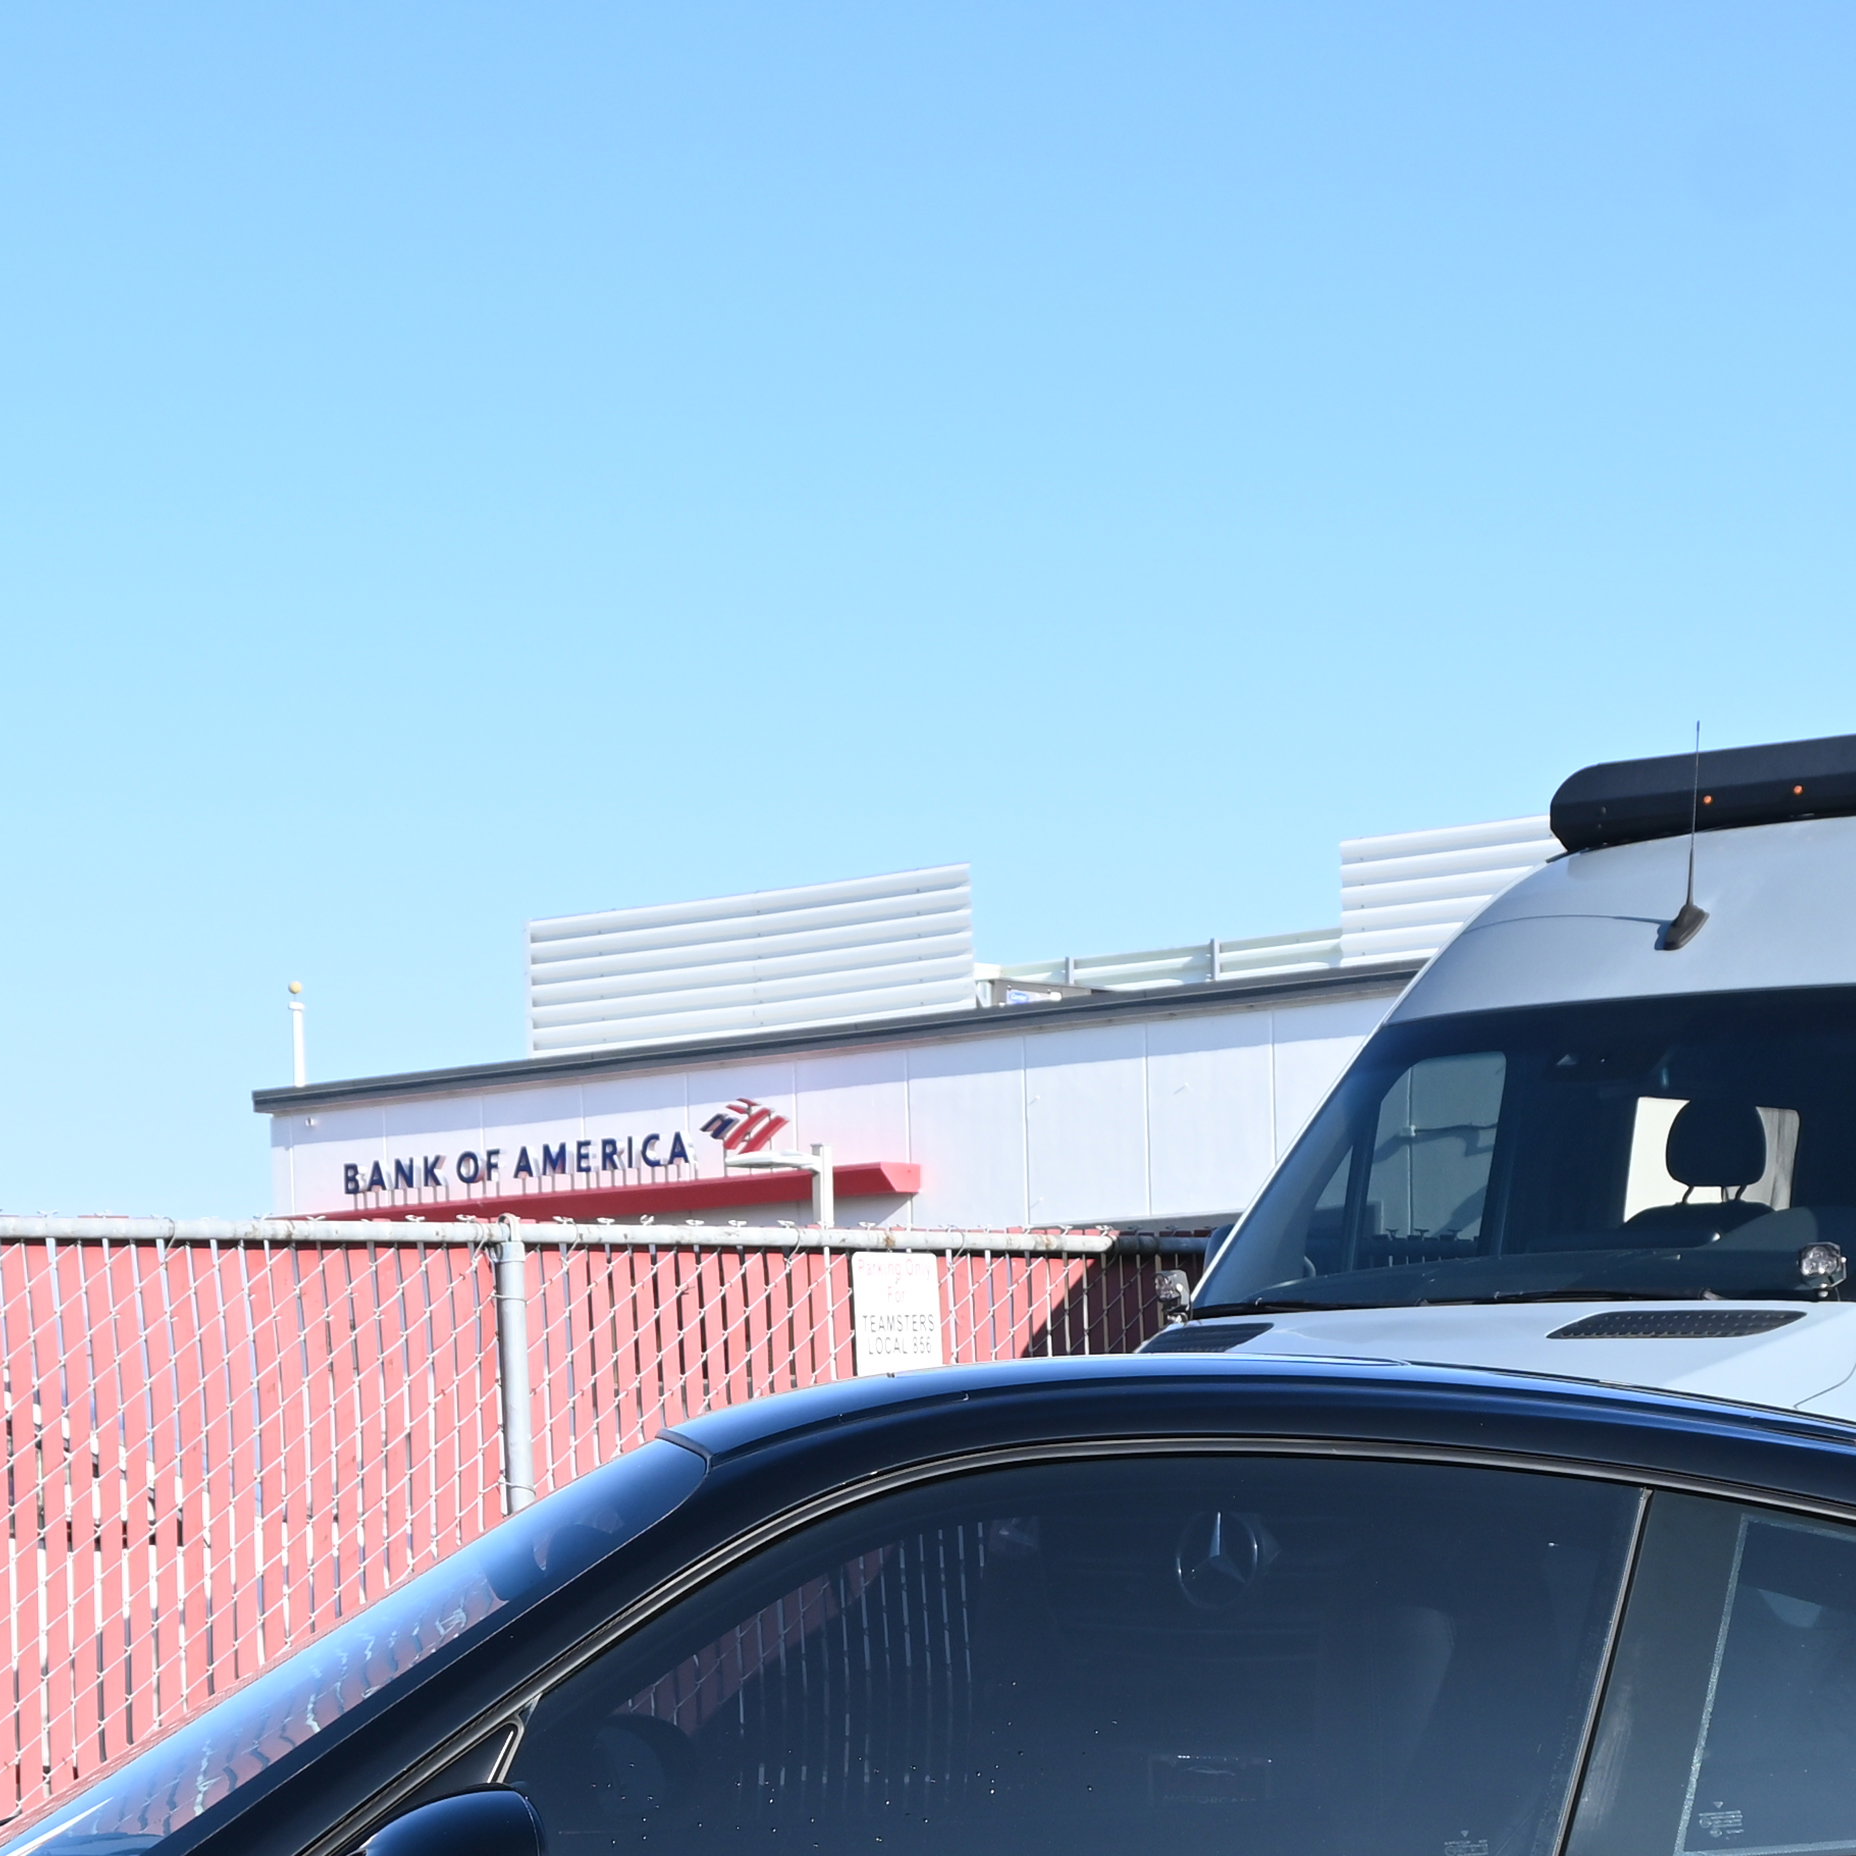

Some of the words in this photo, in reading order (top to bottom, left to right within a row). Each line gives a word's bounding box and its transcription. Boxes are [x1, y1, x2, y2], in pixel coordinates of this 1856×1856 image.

[344, 1155, 444, 1194] BANK
[456, 1149, 501, 1184] OF
[513, 1131, 691, 1178] AMERICA
[858, 1258, 901, 1284] Parking
[904, 1258, 933, 1281] Only
[887, 1286, 905, 1304] For
[862, 1314, 936, 1334] TEAMSTERS
[867, 1336, 909, 1356] LOCAL
